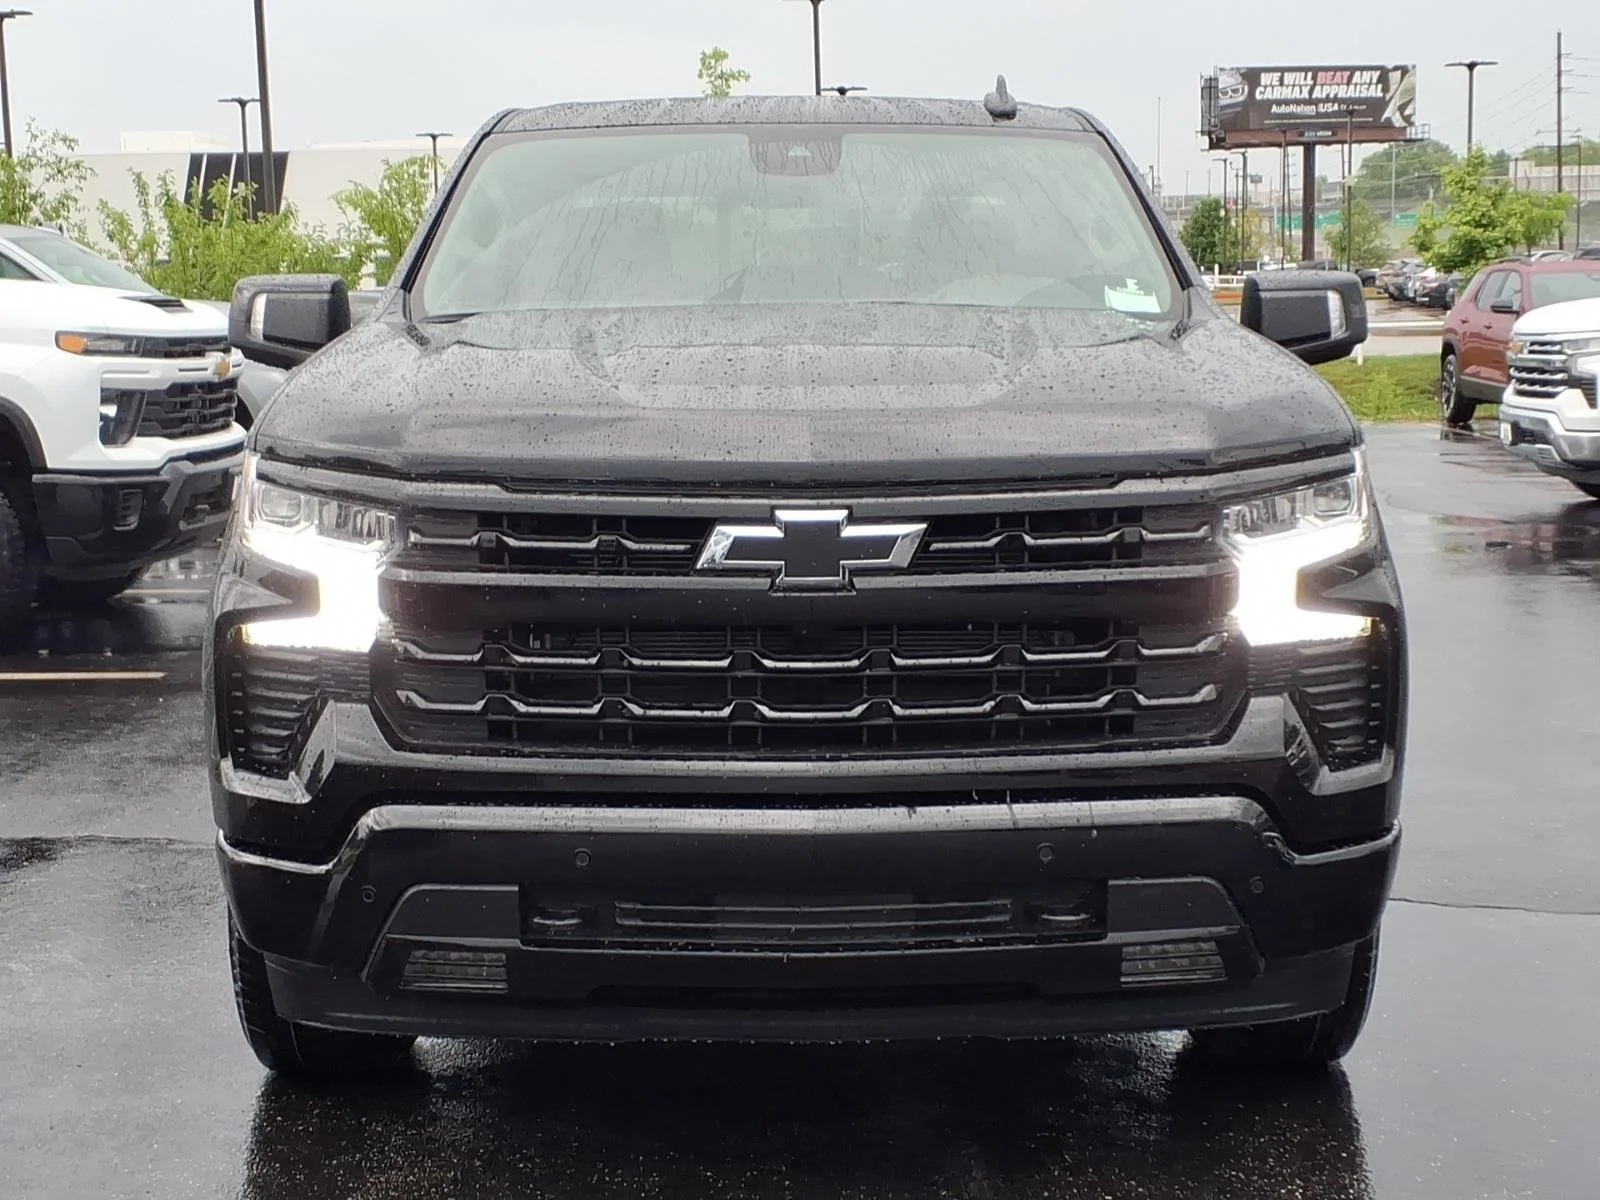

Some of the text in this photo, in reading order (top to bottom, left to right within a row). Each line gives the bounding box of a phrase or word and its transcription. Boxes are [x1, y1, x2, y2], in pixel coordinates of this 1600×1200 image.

[1261, 70, 1381, 86] WE WILL BEAT ANY
[1255, 84, 1383, 100] CARMAX APPRAISAL
[1271, 104, 1316, 115] AutoNation
